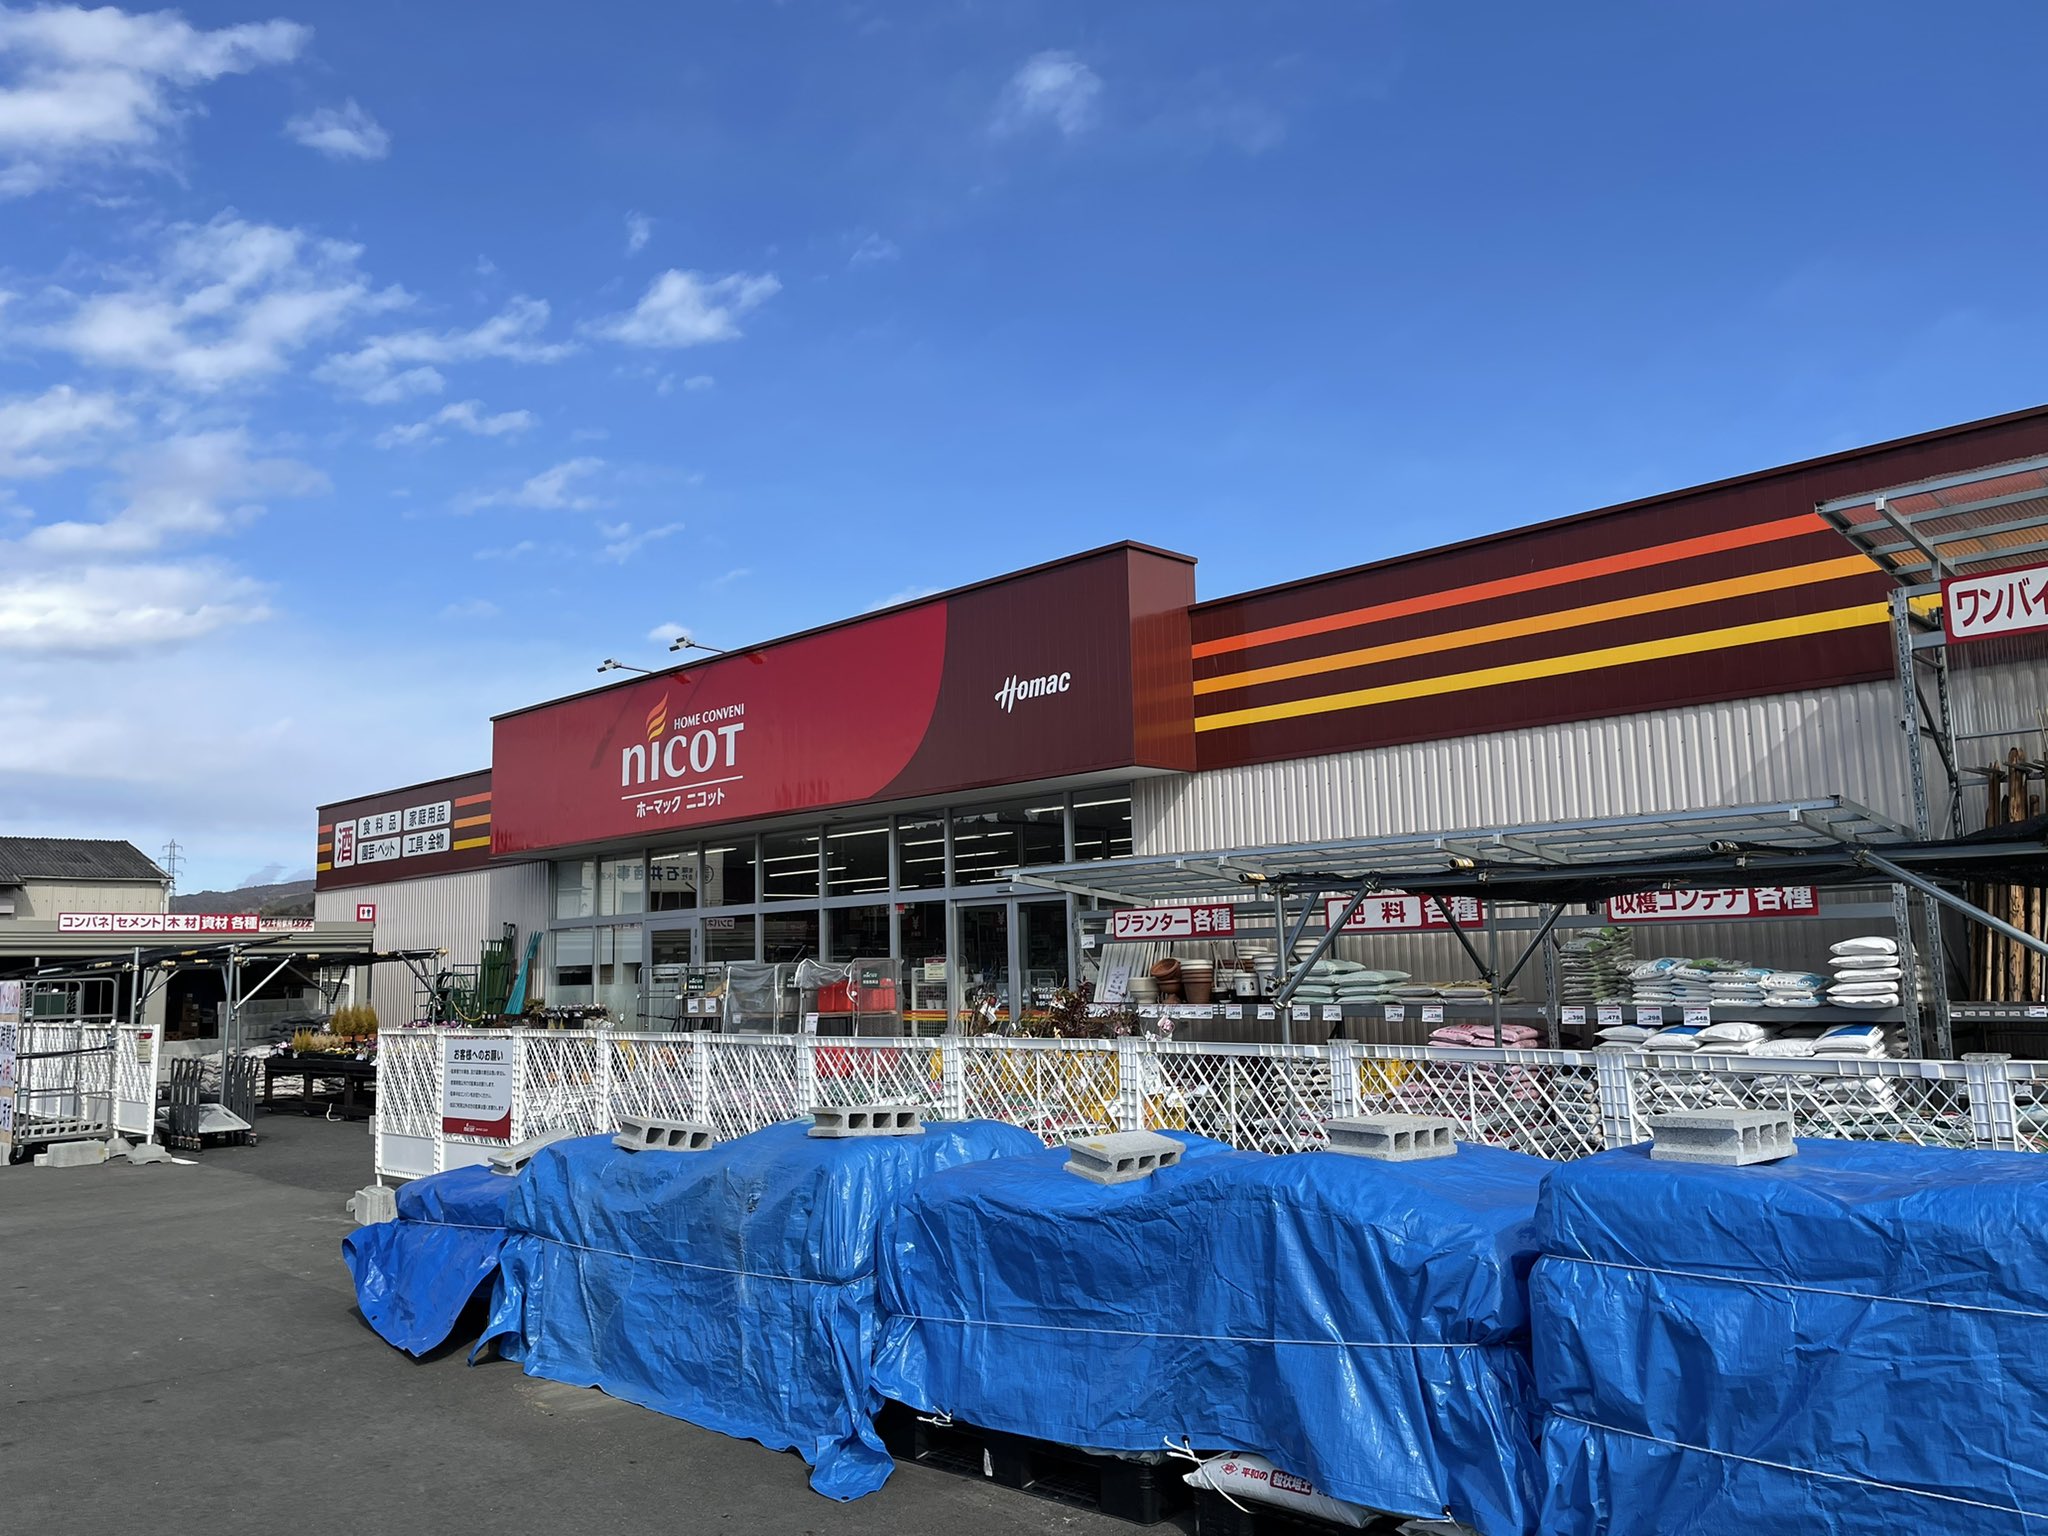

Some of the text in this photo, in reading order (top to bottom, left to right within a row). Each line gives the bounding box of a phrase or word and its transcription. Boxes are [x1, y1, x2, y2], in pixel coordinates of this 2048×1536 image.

[994, 672, 1071, 713] Homac
[673, 703, 745, 730] HOME CONVENI
[409, 805, 445, 827] 家庭用品
[636, 787, 725, 818] ホーマック ニコット
[337, 825, 354, 862] 酒
[1342, 896, 1479, 925] 肥料 各種
[1615, 886, 1814, 914] 収穫コンテナ 各種
[62, 916, 110, 929] コンパネ
[116, 916, 161, 929] セメント
[1117, 908, 1231, 933] プランター 各種
